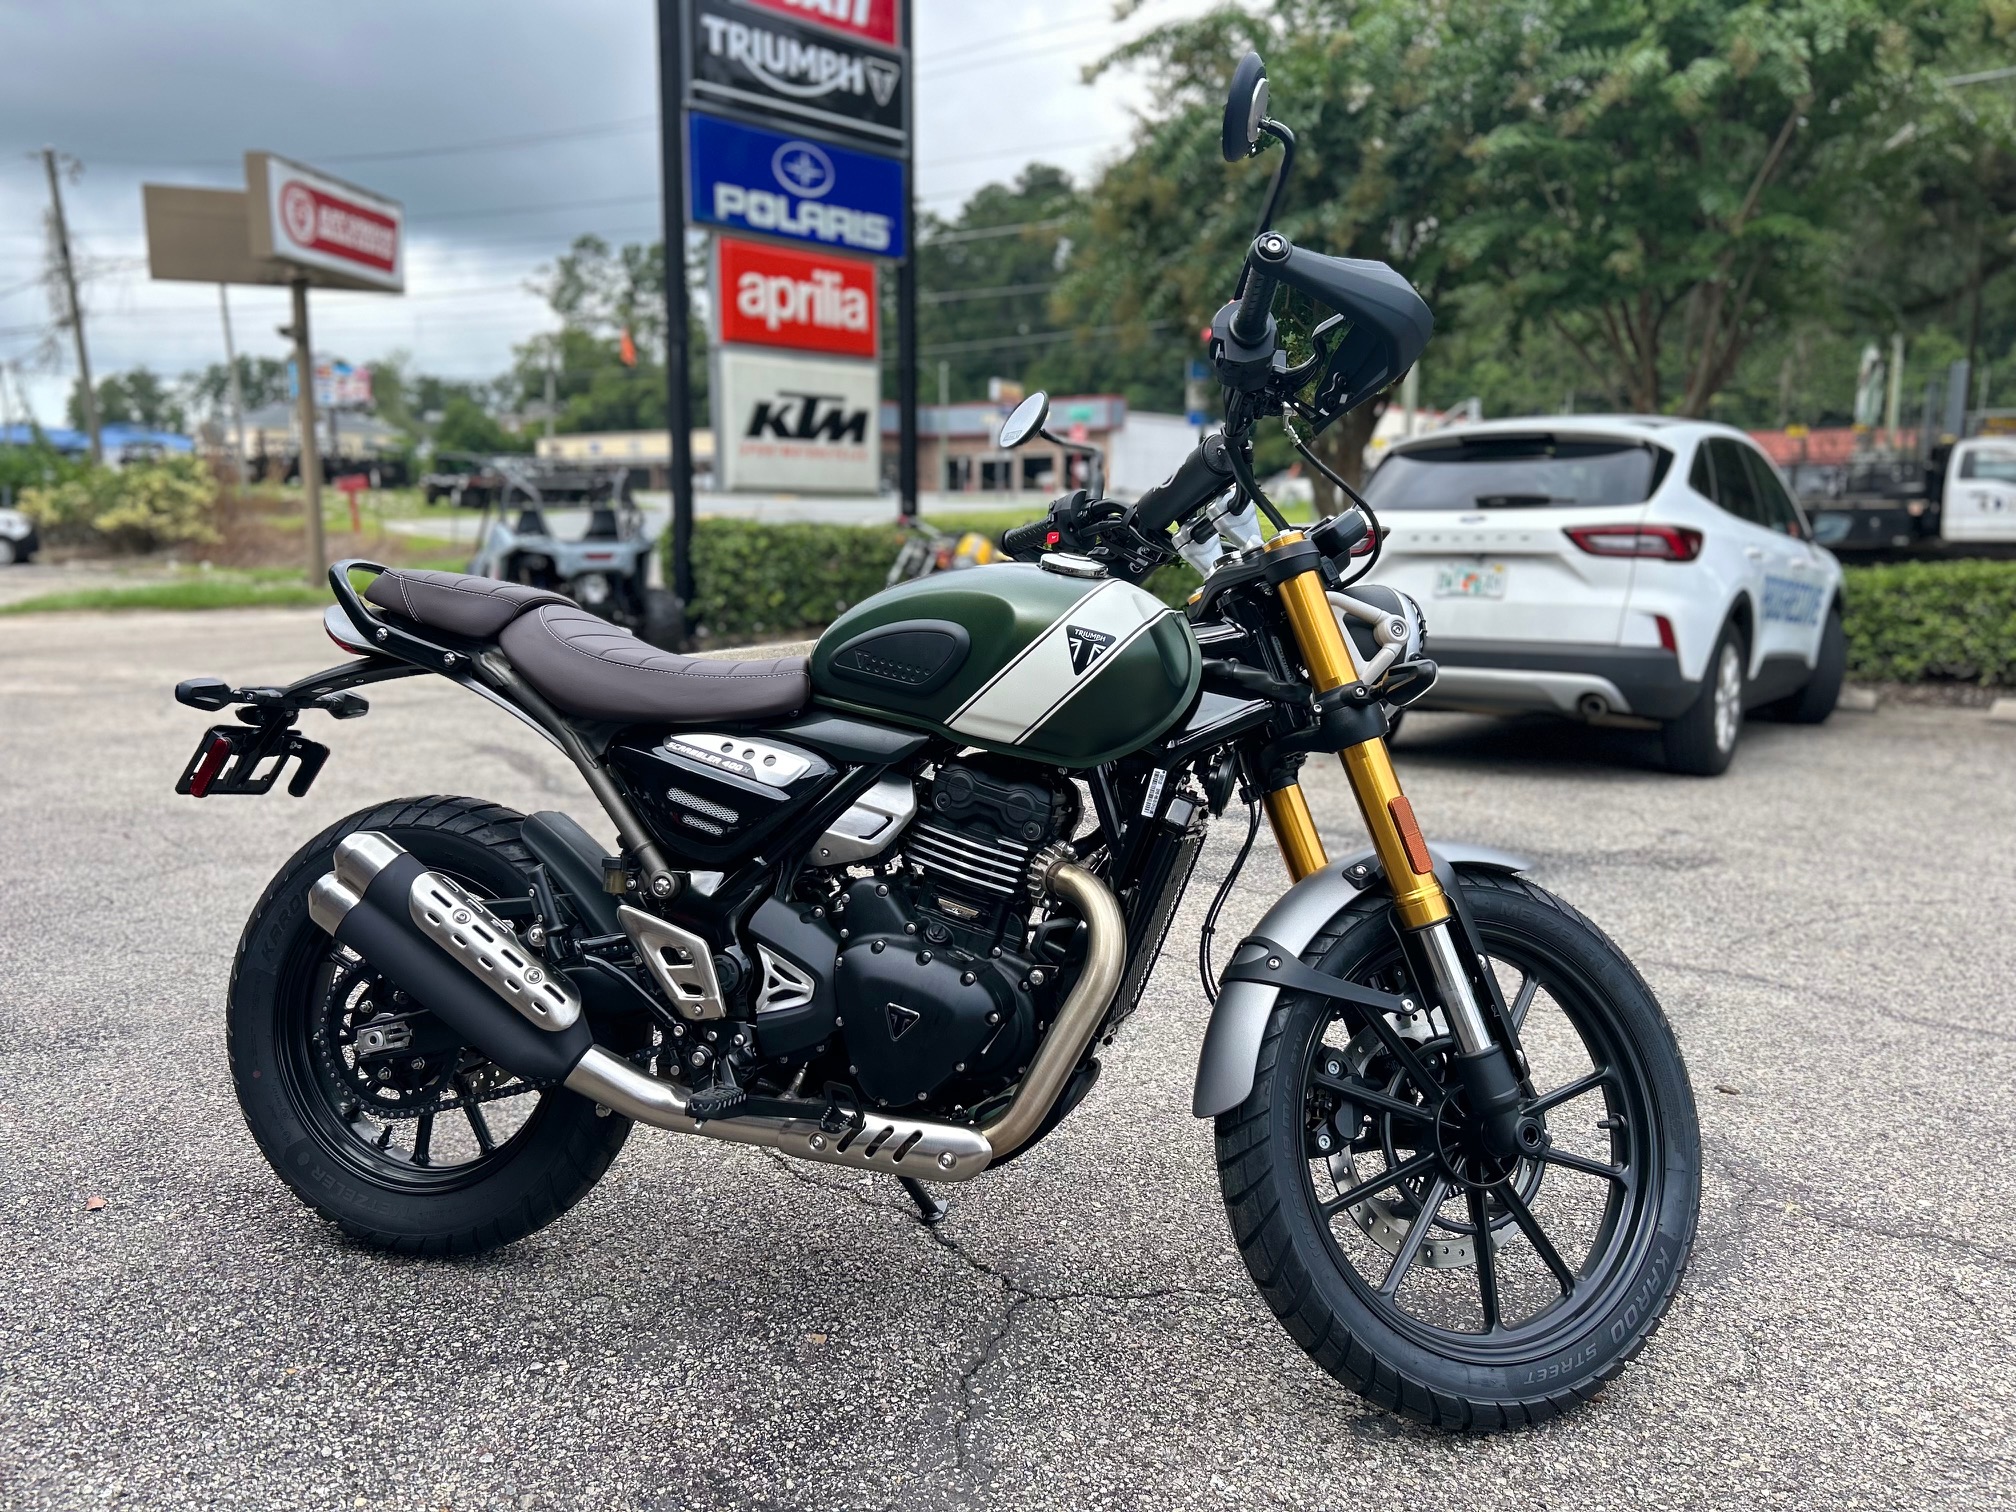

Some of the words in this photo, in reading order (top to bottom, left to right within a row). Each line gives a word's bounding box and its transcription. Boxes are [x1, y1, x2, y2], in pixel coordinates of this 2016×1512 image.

[701, 13, 866, 97] TRIUMPH
[713, 182, 890, 250] POLARIS
[737, 268, 869, 333] aprilia
[746, 390, 870, 444] KTM
[1074, 628, 1106, 642] TRIUMPH
[666, 741, 722, 766] SCRAMBLER
[311, 1164, 411, 1217] METZELER
[1610, 1246, 1671, 1344] KAROO
[1523, 1342, 1597, 1385] STREET
